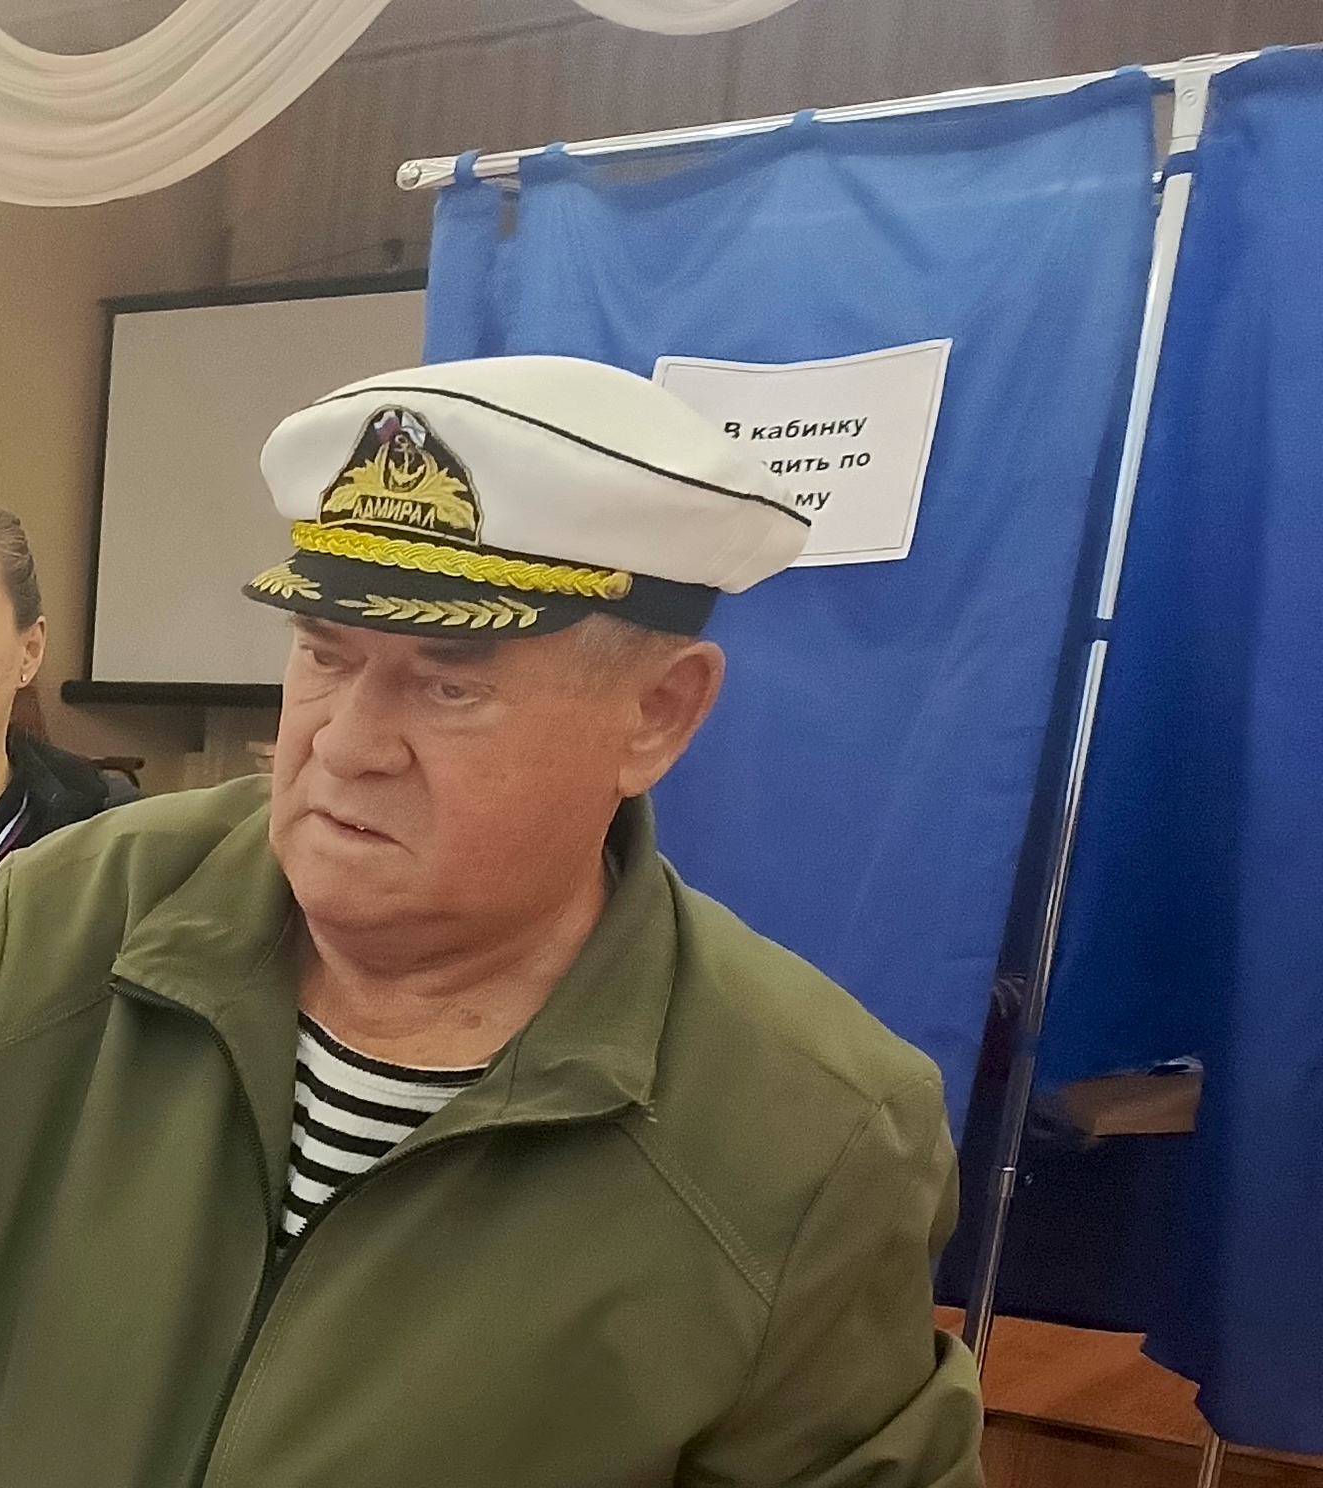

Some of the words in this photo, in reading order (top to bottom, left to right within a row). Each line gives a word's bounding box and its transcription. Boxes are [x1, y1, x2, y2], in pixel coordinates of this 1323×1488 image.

[750, 415, 869, 441] кабинку
[763, 455, 831, 478] дить
[839, 452, 873, 470] по
[351, 496, 436, 530] АДМИРАЛ
